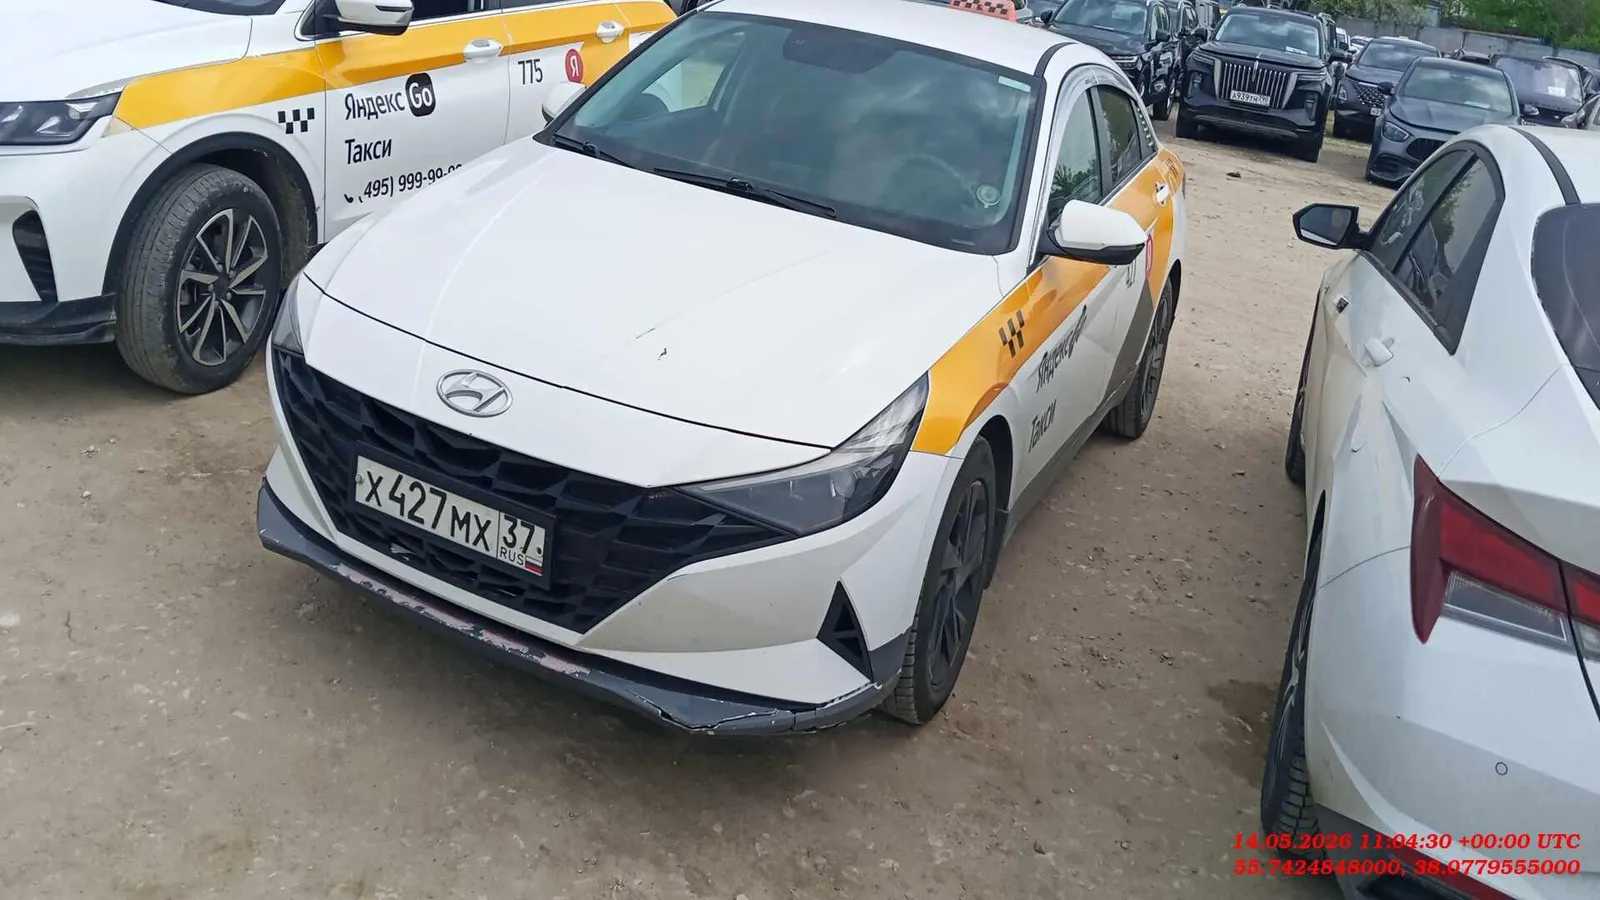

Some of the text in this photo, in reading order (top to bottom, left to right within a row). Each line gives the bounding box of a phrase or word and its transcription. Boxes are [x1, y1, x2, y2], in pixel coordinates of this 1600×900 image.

[518, 58, 543, 85] 775
[570, 54, 579, 77] Я
[344, 82, 433, 120] Яндекс Go
[344, 138, 392, 164] Такси
[1028, 399, 1057, 453] Такси
[500, 546, 524, 567] RUS
